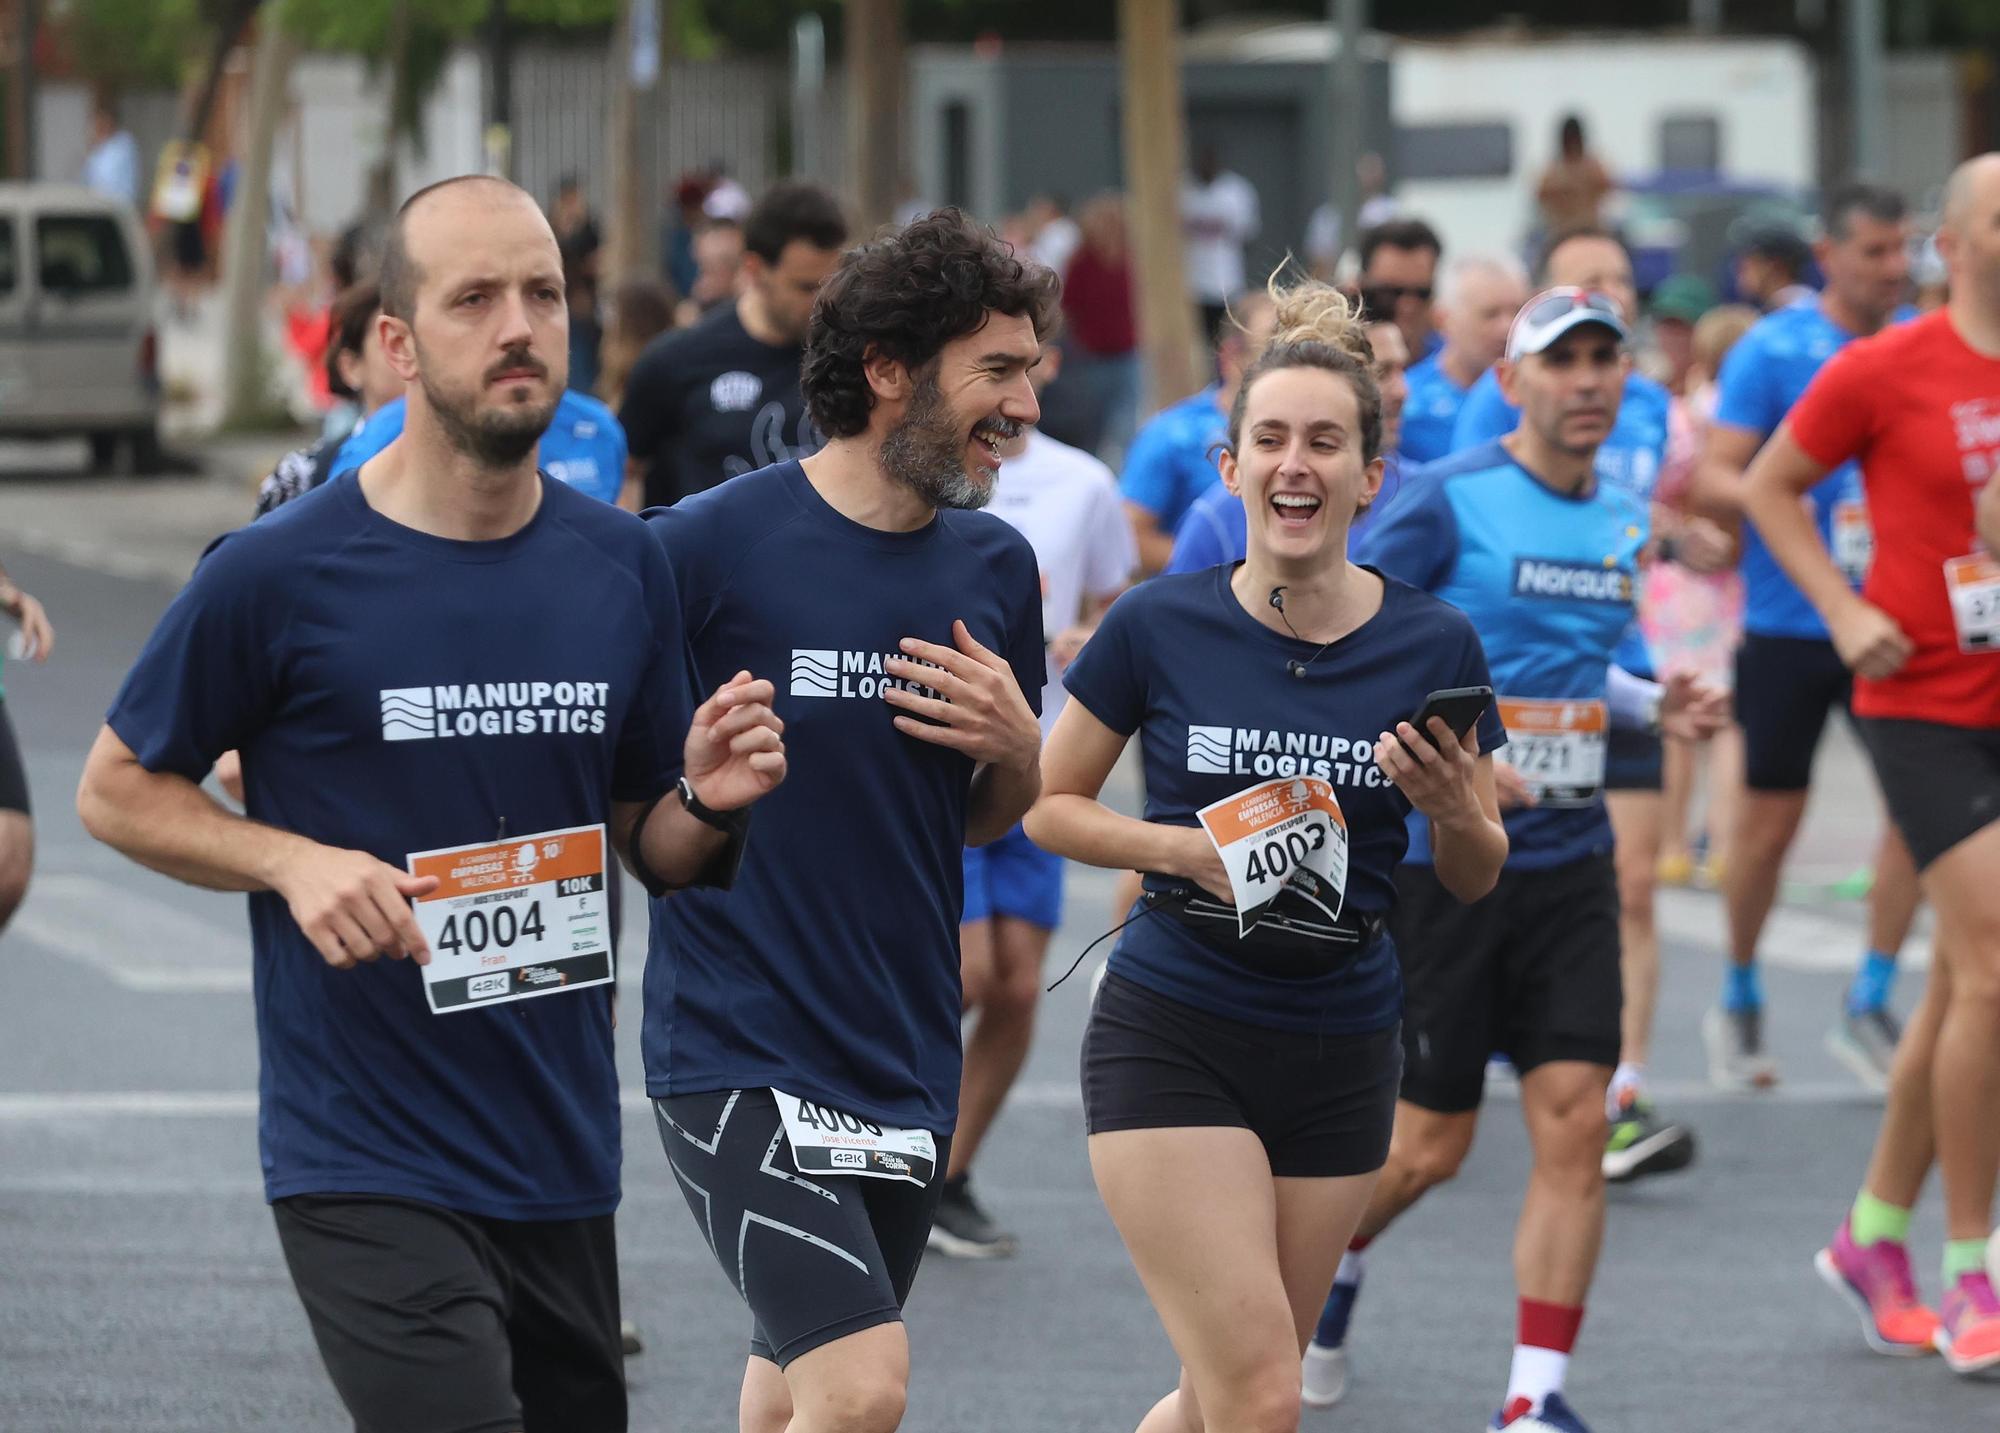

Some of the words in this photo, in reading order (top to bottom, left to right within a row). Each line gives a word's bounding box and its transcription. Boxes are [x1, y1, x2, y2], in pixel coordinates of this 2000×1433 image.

[434, 682, 609, 710] MANUPORT
[437, 709, 606, 737] LOGISTICS
[1235, 728, 1383, 764] MANUPO
[1238, 797, 1280, 821] EMPRESAS
[1248, 805, 1285, 827] VALENCIA
[1247, 823, 1325, 885] 4003
[561, 876, 592, 894] 10K
[438, 900, 546, 956] 4004
[472, 978, 505, 992] 42K
[821, 1134, 840, 1145] Jose
[841, 1136, 877, 1146] Vicente
[834, 1153, 863, 1164] 42K
